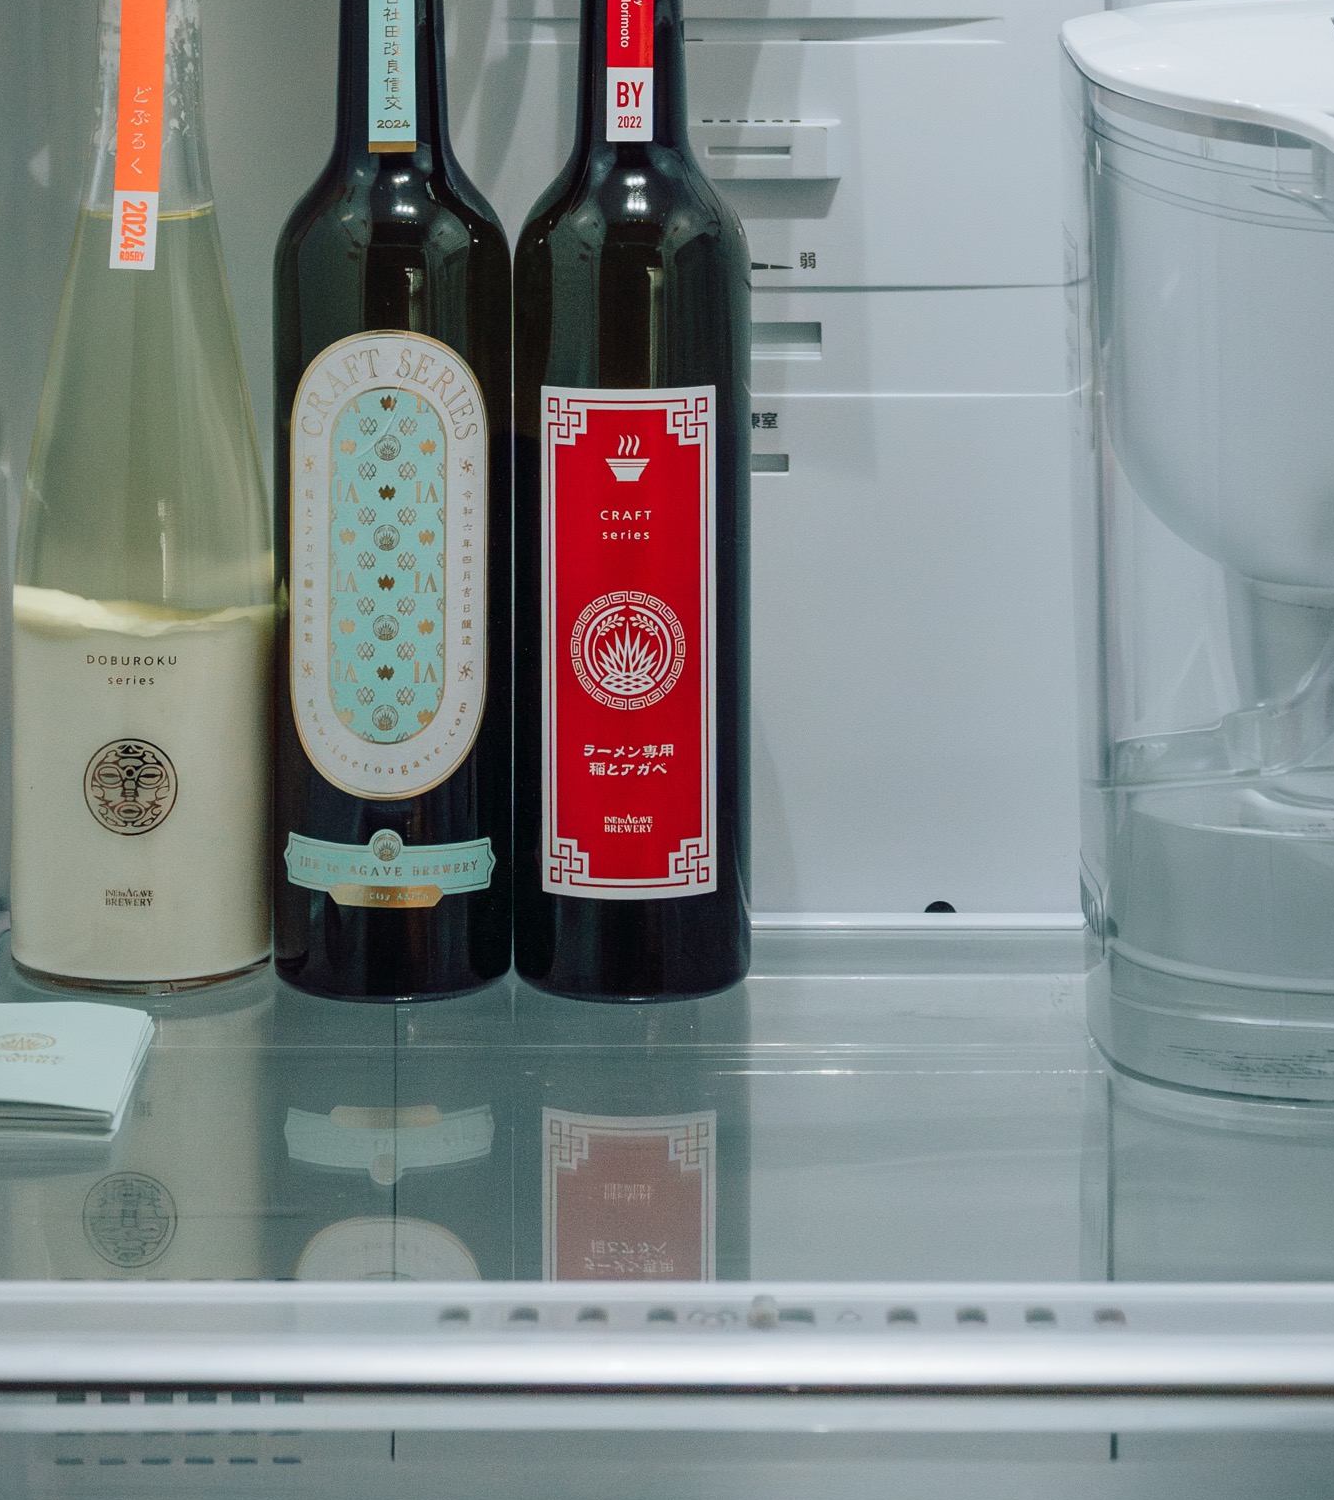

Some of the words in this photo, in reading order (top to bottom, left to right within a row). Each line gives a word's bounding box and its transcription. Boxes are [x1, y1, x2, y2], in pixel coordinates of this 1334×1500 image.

[616, 81, 644, 108] BY
[376, 119, 411, 129] 2024
[617, 115, 642, 129] 2022
[130, 86, 153, 175] どぶろく
[120, 200, 148, 250] 2024
[799, 251, 817, 270] 弱
[301, 348, 380, 439] CRAFT
[396, 348, 478, 441] SERIES
[599, 510, 652, 521] CRAFT
[602, 530, 650, 540] series
[86, 655, 177, 666] DOBUROKU
[107, 675, 155, 685] series
[583, 743, 675, 759] ラーメン専用
[589, 761, 668, 776] 稲とアガベ
[604, 824, 654, 833] BREWERY
[349, 865, 403, 877] AGAVE
[105, 898, 154, 906] BREWERY
